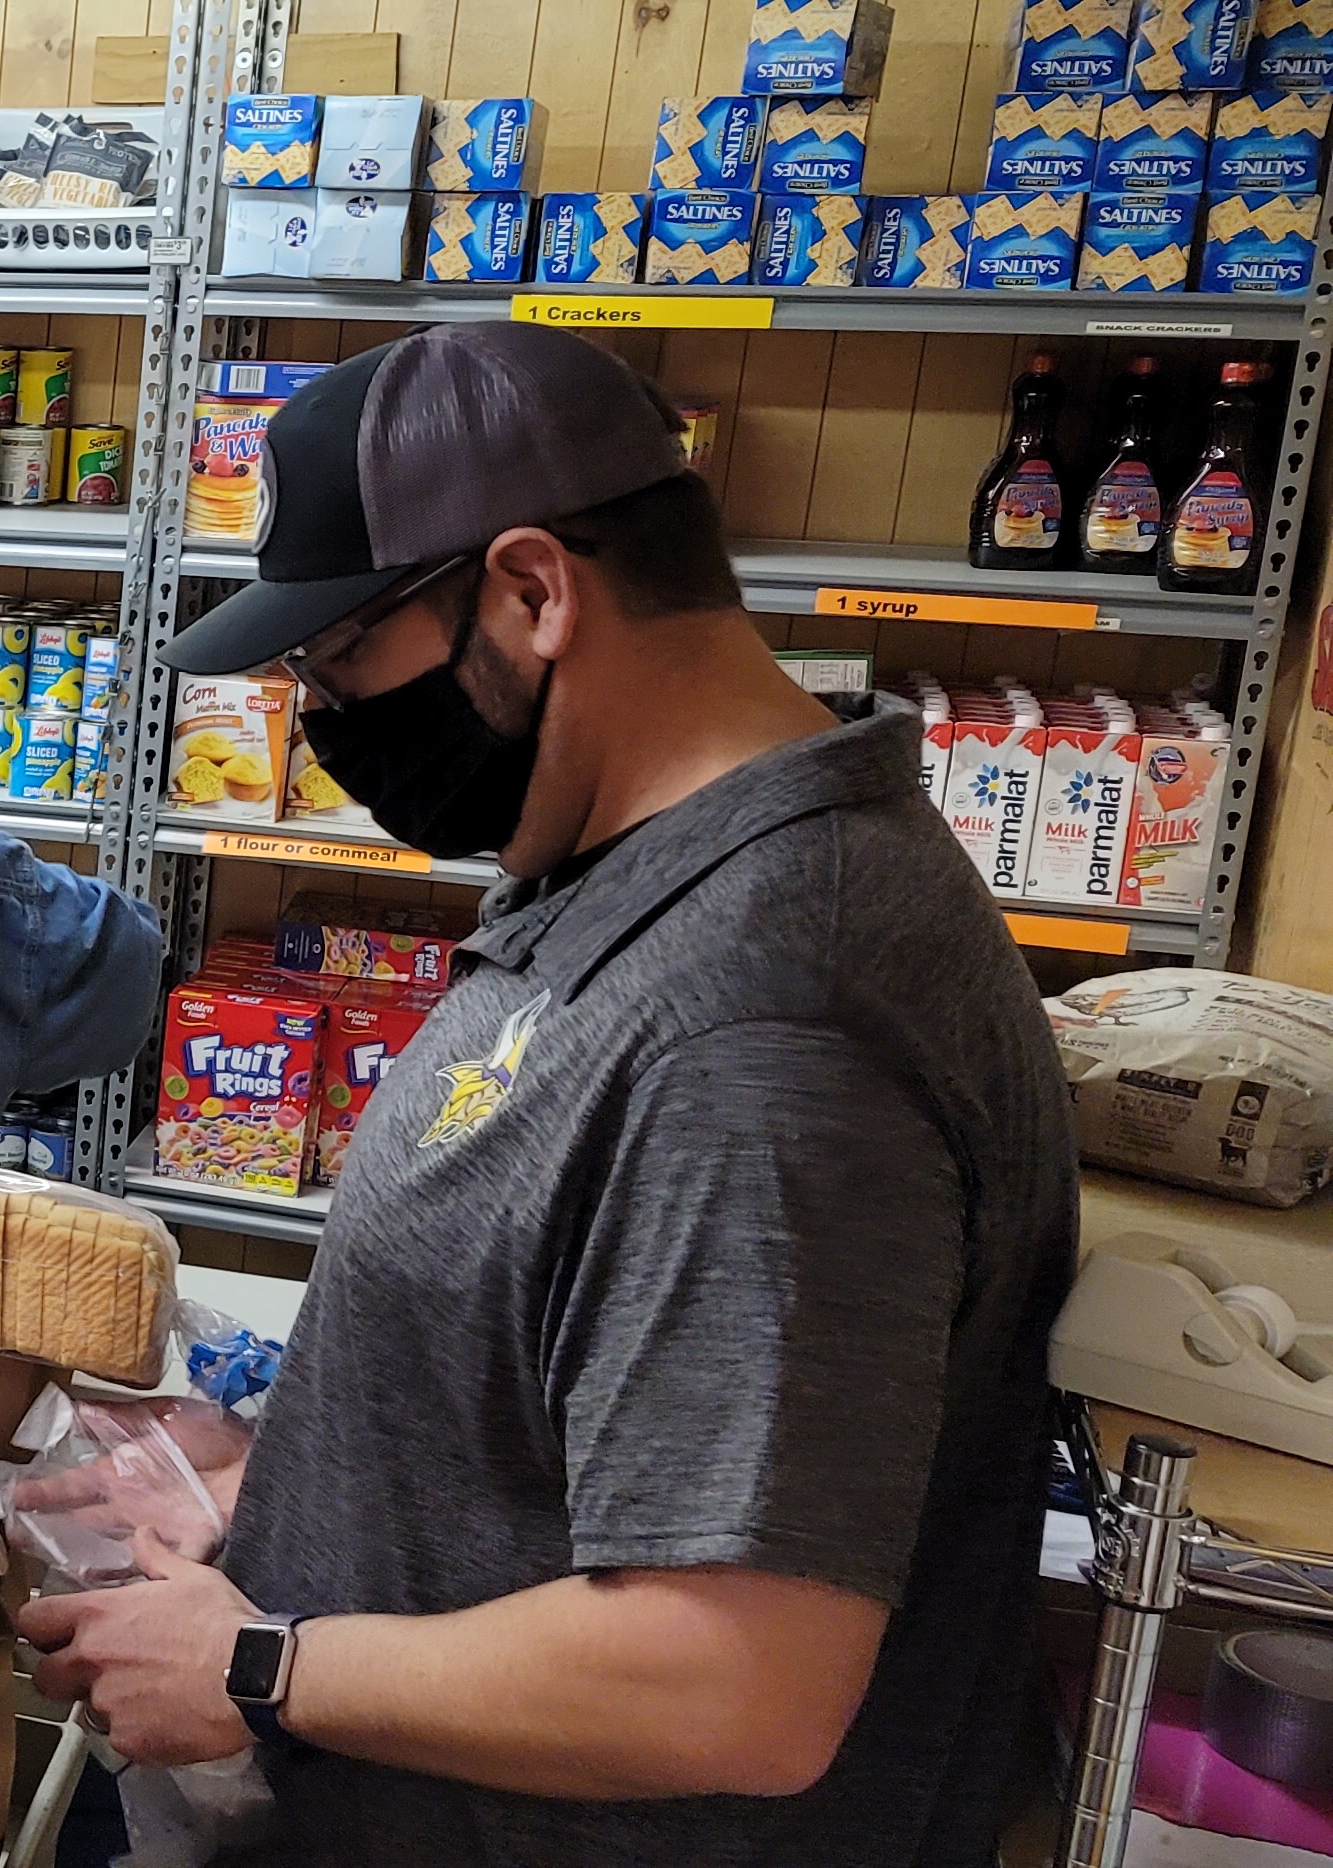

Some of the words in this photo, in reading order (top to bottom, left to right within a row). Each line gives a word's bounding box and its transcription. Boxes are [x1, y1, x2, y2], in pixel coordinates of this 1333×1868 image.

[757, 62, 835, 79] SALTINES
[235, 108, 302, 124] SALTINES
[492, 108, 517, 179] SALTINES
[722, 107, 749, 179] SALTINES
[772, 162, 851, 179] SALTINES
[1002, 160, 1083, 176] SALTINES
[1109, 160, 1192, 176] SALTINES
[1221, 160, 1306, 176] SALTINES
[667, 204, 743, 221] SALTINES
[1099, 207, 1182, 224] SALTINES
[491, 202, 515, 271] SALTINES
[552, 205, 574, 274] SALTINES
[529, 307, 537, 320] 1
[547, 307, 641, 322] Crackers
[1096, 323, 1144, 332] SNACK
[1147, 324, 1221, 333] CRACKERS
[194, 413, 268, 444] Pancak
[88, 438, 114, 449] Save
[836, 595, 847, 610] 1
[855, 599, 919, 618] syrup
[183, 684, 217, 704] Corn
[26, 746, 59, 758] SLICED
[953, 814, 995, 832] Milk
[993, 768, 1030, 889] parmalat
[1045, 821, 1088, 839] Milk
[1086, 775, 1124, 896] parmalat
[1135, 817, 1200, 848] MILK
[220, 836, 229, 849] 1
[237, 837, 279, 853] flour
[284, 841, 303, 854] or
[308, 844, 398, 864] cornmeal
[181, 1000, 215, 1015] Golden
[188, 1033, 291, 1077] Fruit
[213, 1072, 282, 1097] Rings
[249, 1101, 280, 1113] Cereal
